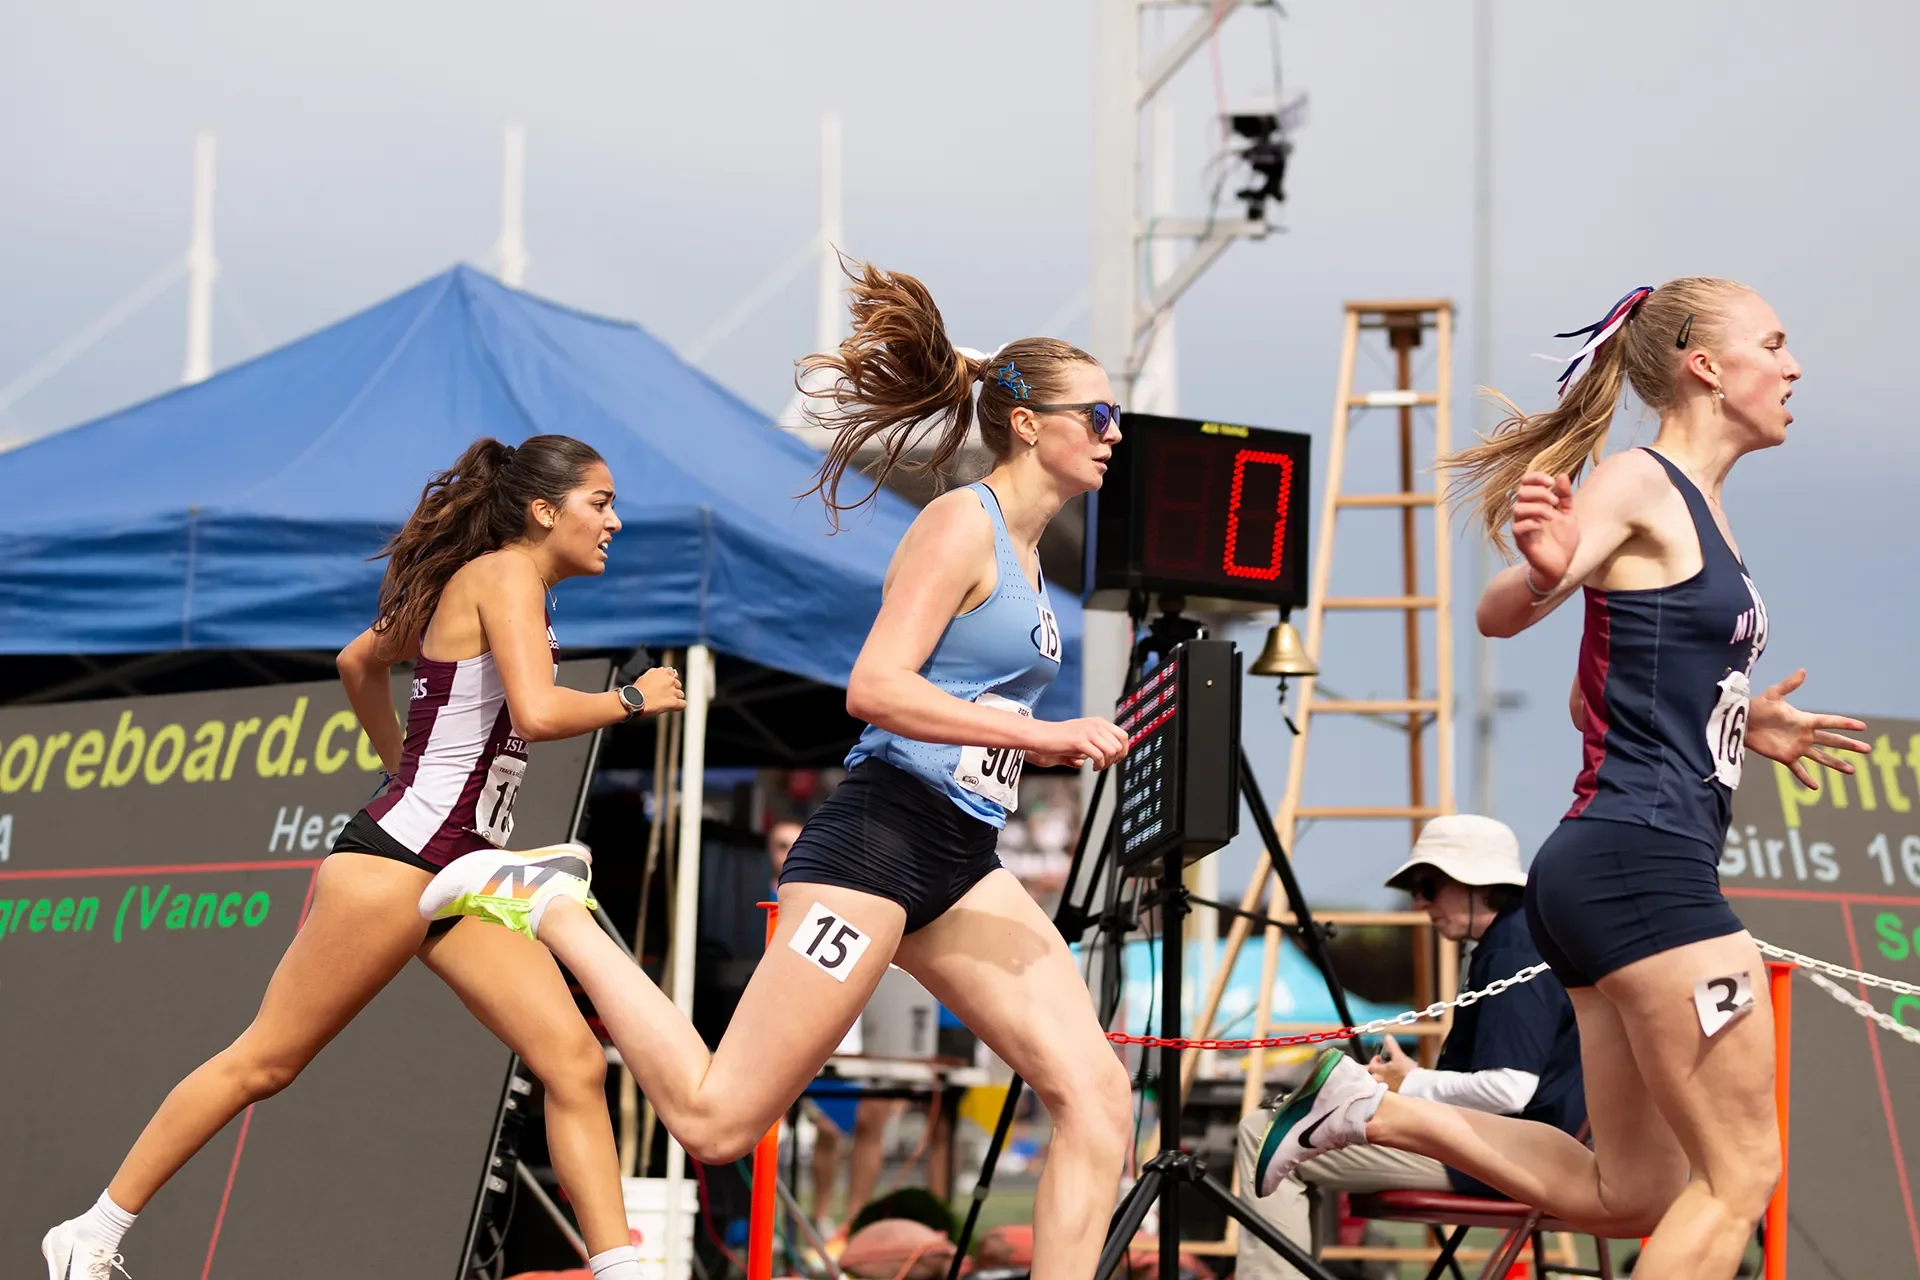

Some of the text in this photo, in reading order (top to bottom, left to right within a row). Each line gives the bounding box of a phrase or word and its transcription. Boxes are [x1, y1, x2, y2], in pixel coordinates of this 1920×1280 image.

[1224, 449, 1293, 580] 0
[1719, 825, 1840, 882] Girls
[113, 884, 270, 943] (Vanco
[806, 916, 860, 968] 15
[1875, 912, 1920, 961] S
